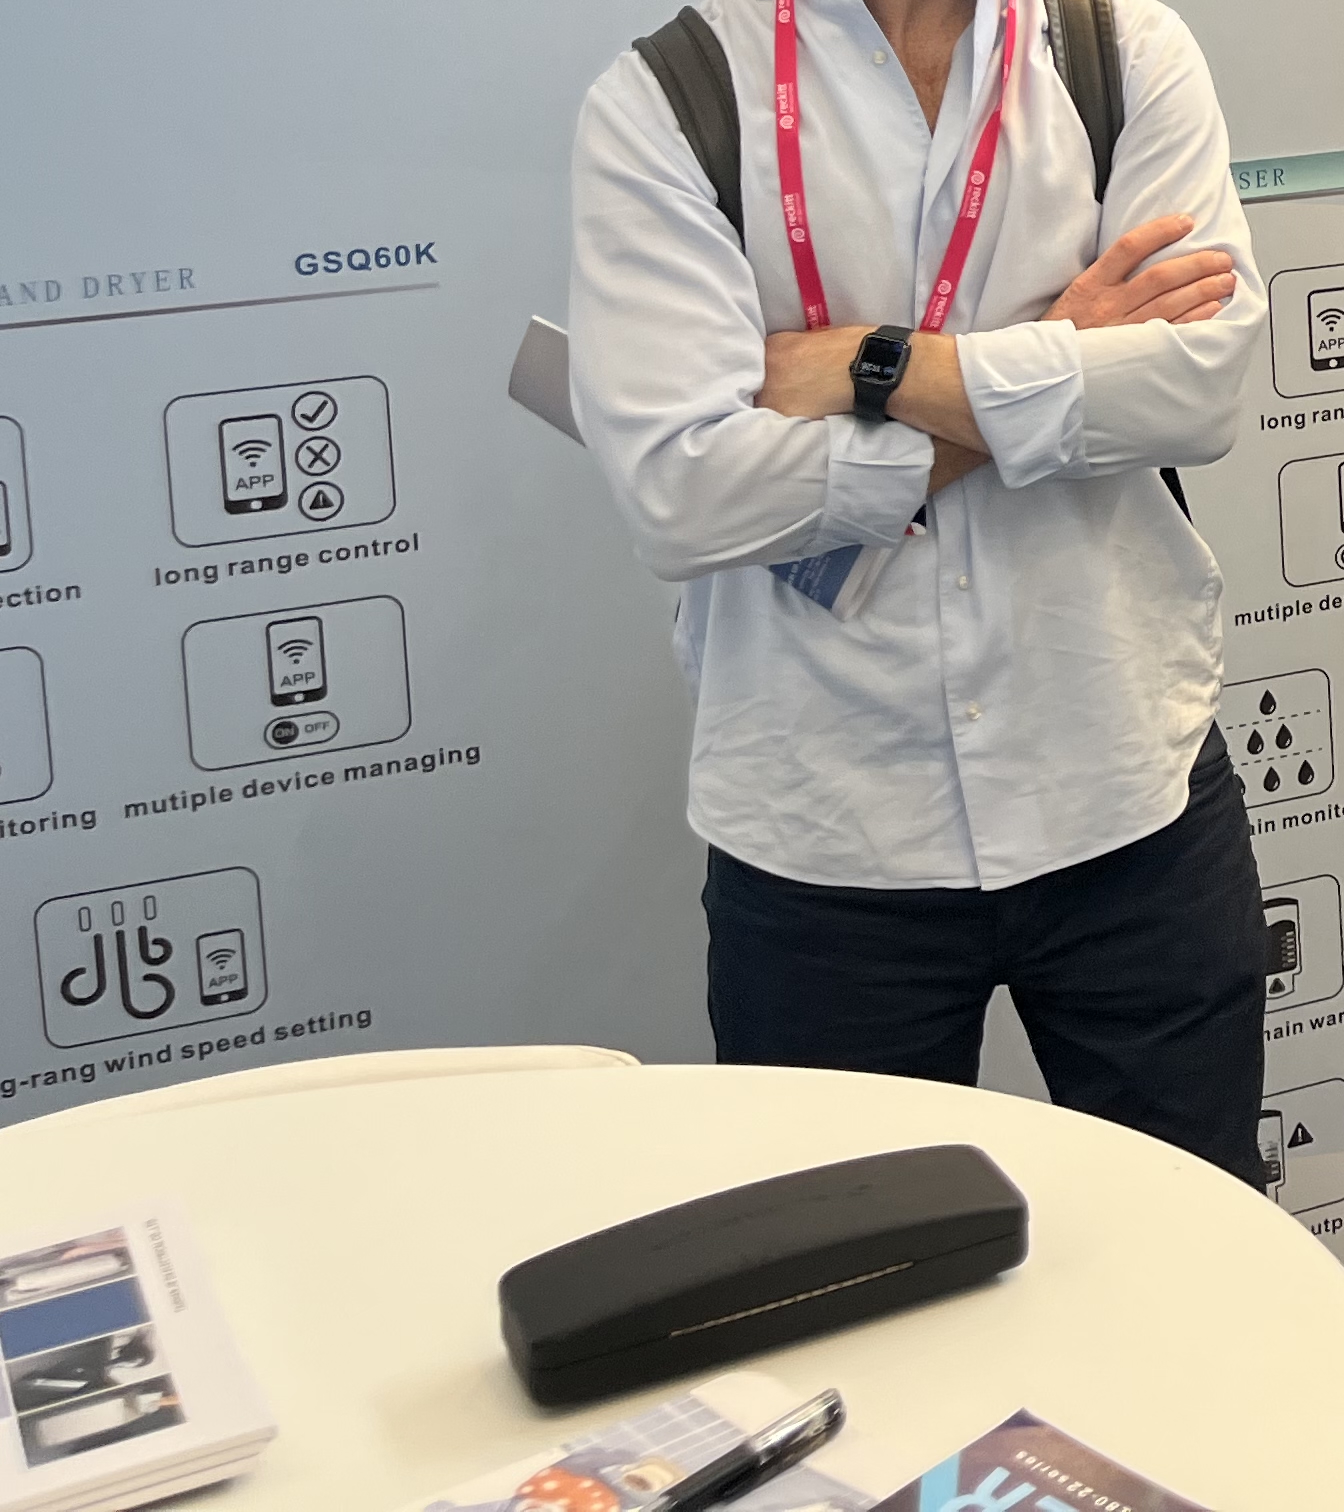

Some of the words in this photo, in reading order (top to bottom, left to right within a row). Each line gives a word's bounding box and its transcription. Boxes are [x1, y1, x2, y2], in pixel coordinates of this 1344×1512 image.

[1238, 168, 1286, 190] SER
[82, 268, 196, 300] DRYER
[294, 241, 439, 276] GSQ60K
[1260, 414, 1306, 432] long
[235, 473, 275, 491] APP
[154, 562, 220, 588] long
[227, 550, 310, 577] range
[318, 534, 420, 565] control
[1234, 600, 1313, 626] mutiple
[280, 671, 316, 687] APP
[123, 784, 234, 819] mutiple
[241, 768, 335, 799] device
[344, 743, 482, 782] managing
[208, 973, 239, 989] APP
[104, 1044, 173, 1074] wind
[181, 1027, 266, 1061] speed
[273, 1009, 373, 1041] setting
